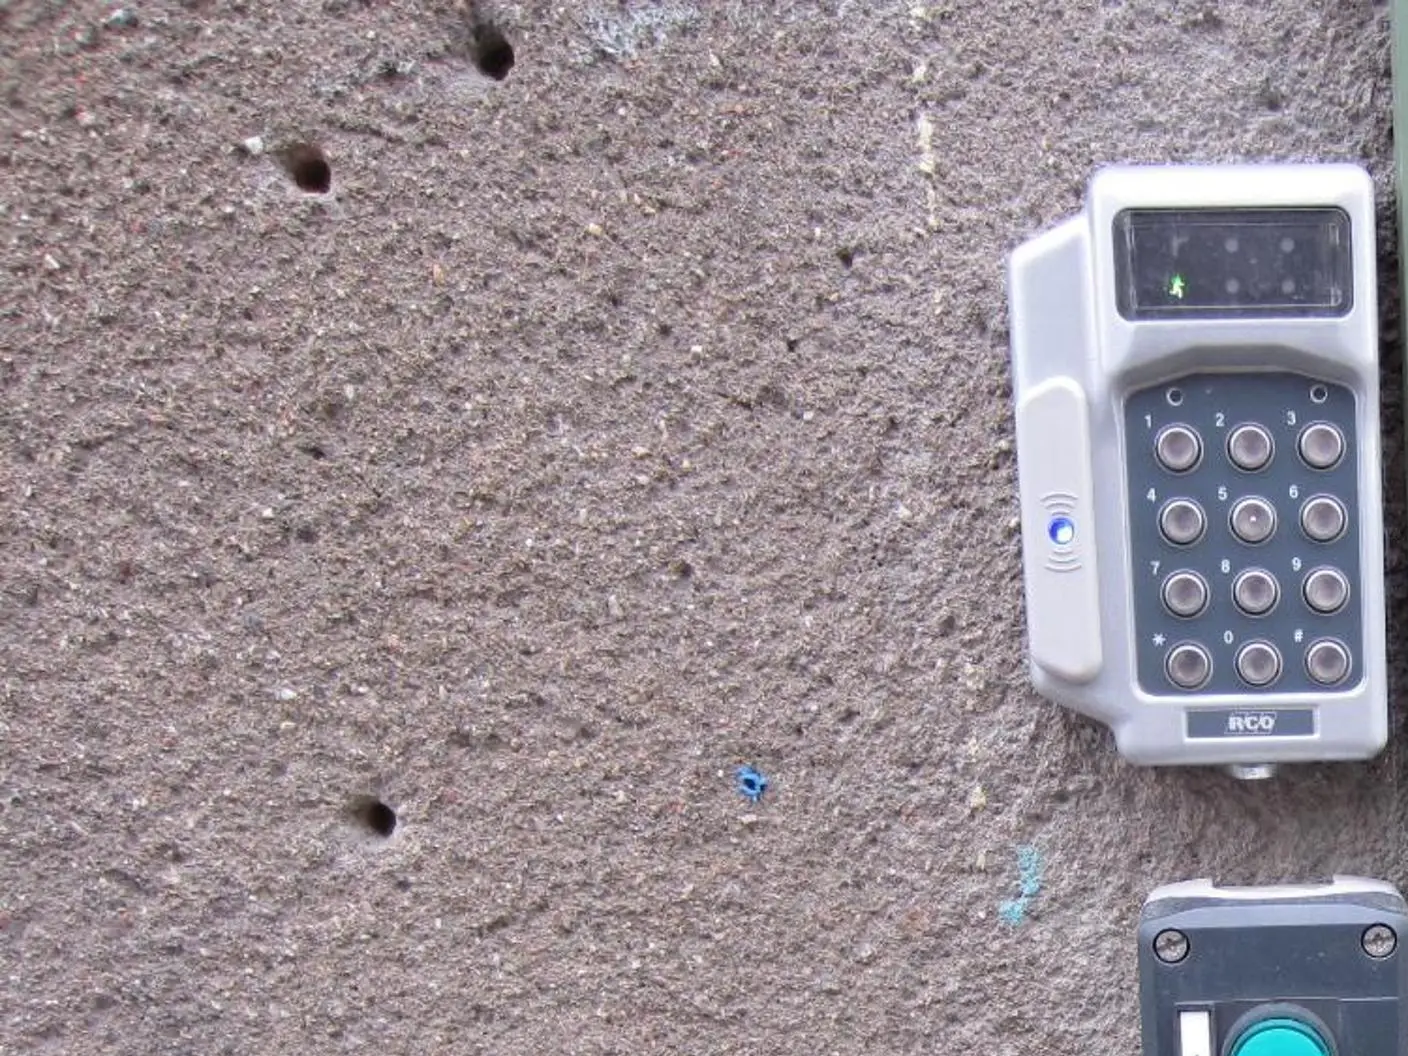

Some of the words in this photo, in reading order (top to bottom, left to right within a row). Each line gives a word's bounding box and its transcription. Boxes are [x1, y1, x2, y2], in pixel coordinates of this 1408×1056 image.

[1215, 412, 1225, 426] 2
[1287, 410, 1296, 425] 3
[1147, 488, 1156, 502] 4
[1218, 486, 1227, 500] 5
[1289, 485, 1298, 498] 6
[1151, 560, 1160, 575] 7
[1221, 559, 1230, 573] 8
[1292, 557, 1301, 571] 9
[1223, 630, 1233, 644] 0
[1294, 628, 1303, 642] #
[1227, 715, 1275, 731] RCO
